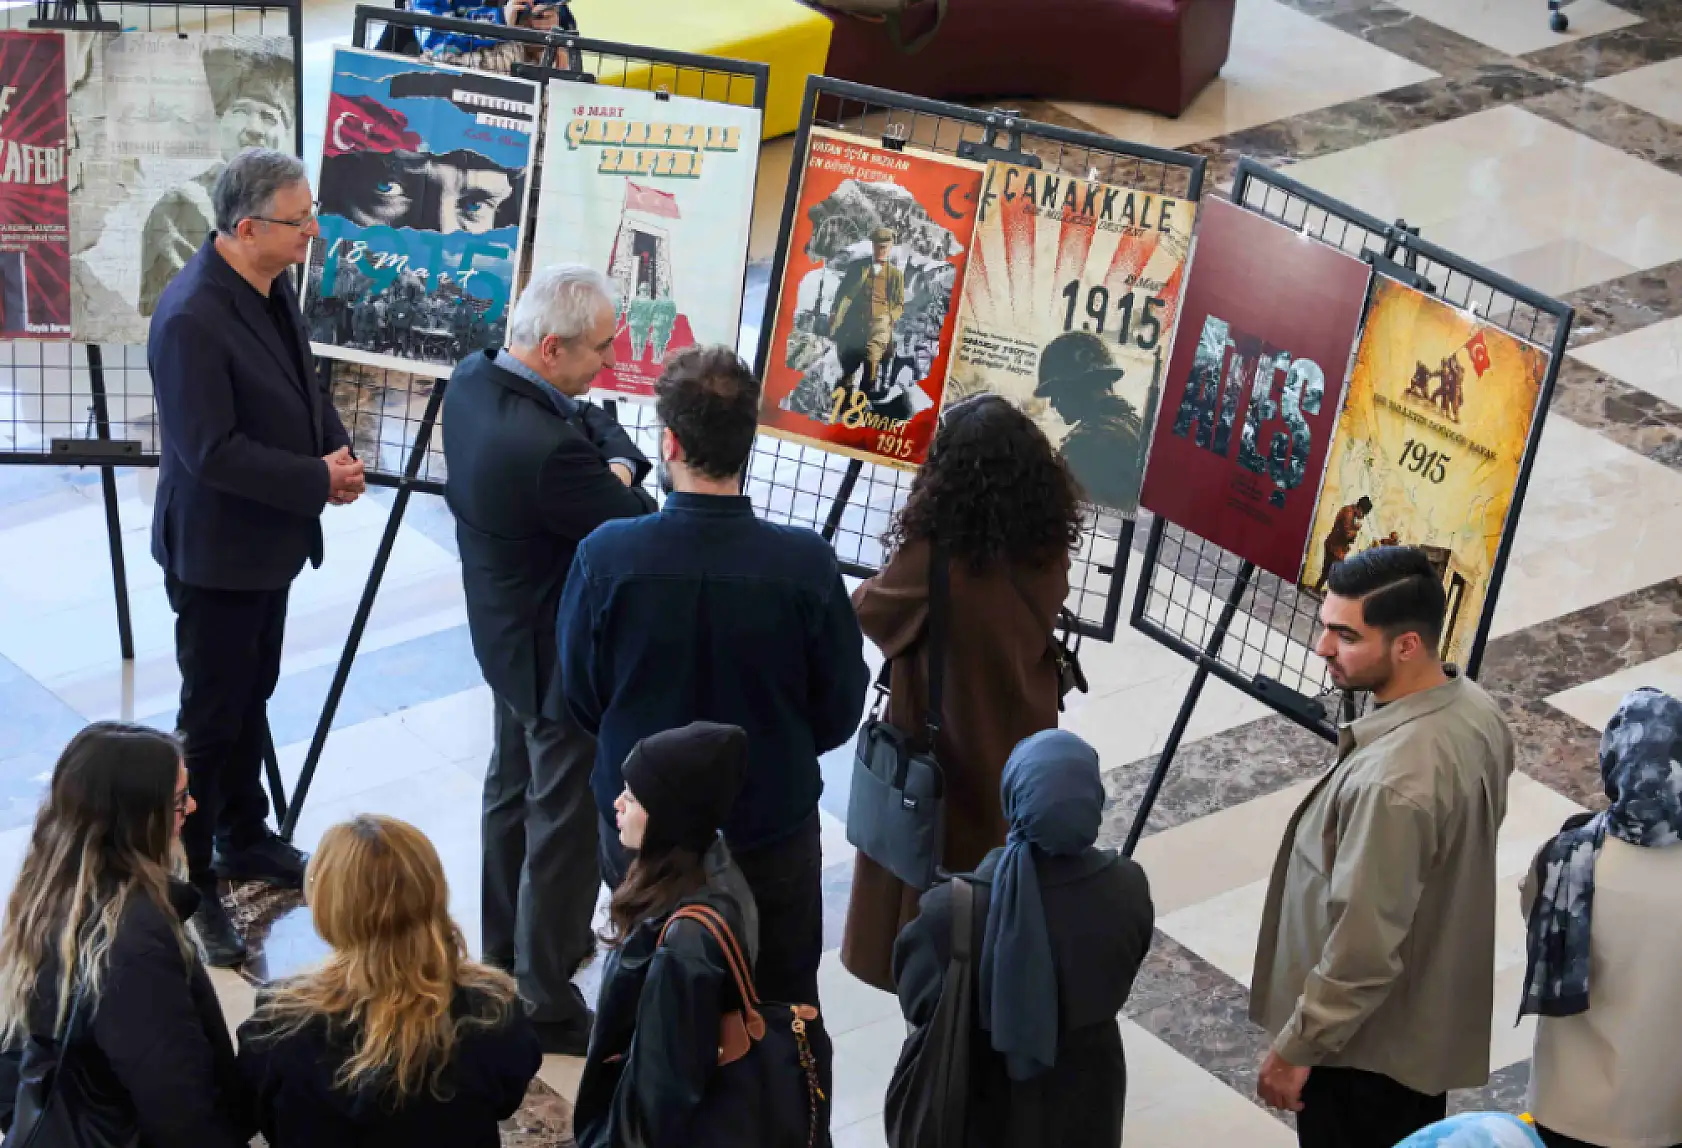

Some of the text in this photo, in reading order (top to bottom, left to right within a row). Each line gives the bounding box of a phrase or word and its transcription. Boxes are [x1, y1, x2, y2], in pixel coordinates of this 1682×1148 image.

[328, 237, 479, 289] 18 Mart
[1063, 279, 1166, 350] 1915
[829, 386, 910, 435] 18 MART
[877, 433, 914, 457] 1915
[1399, 438, 1451, 484] 1915
